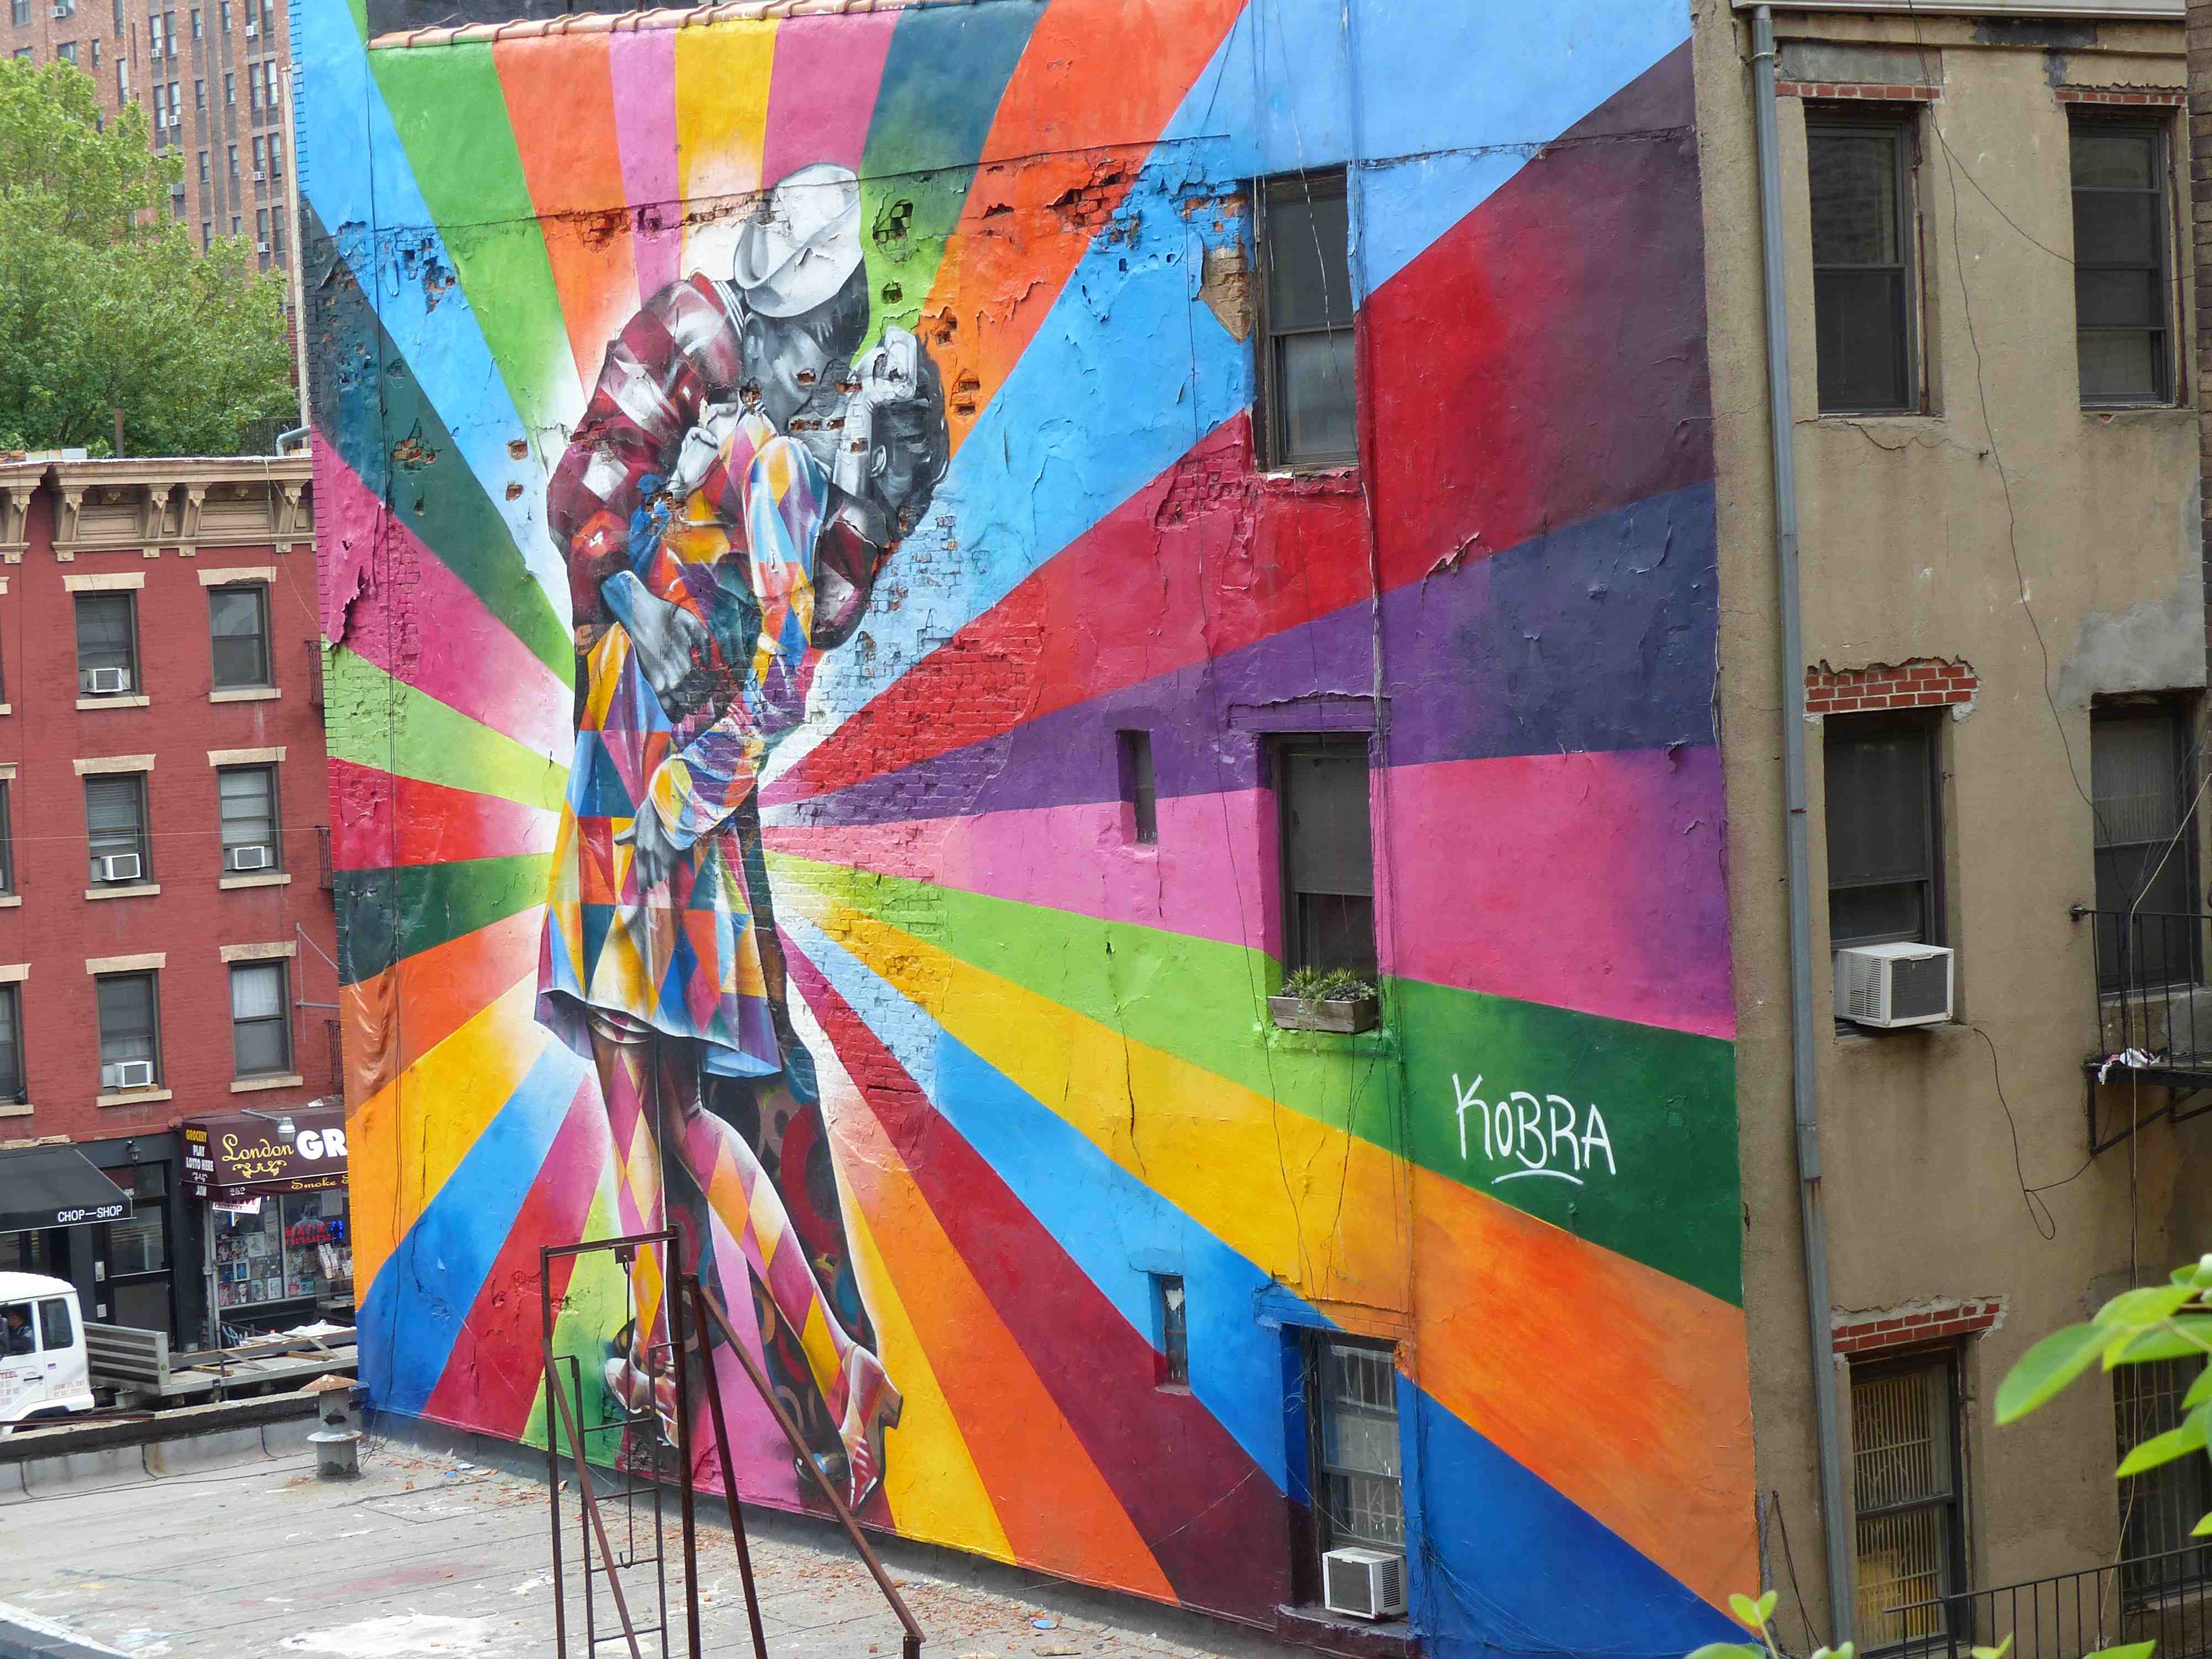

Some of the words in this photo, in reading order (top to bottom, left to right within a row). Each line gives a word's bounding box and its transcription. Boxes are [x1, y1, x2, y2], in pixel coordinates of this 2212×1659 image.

[1452, 1073, 1616, 1175] KOBRA
[192, 1144, 205, 1157] PLAY
[222, 1134, 294, 1162] London
[186, 1157, 200, 1170] LOTTO
[201, 1159, 214, 1172] HERE
[291, 1176, 337, 1190] Smoke
[229, 1186, 246, 1196] 252
